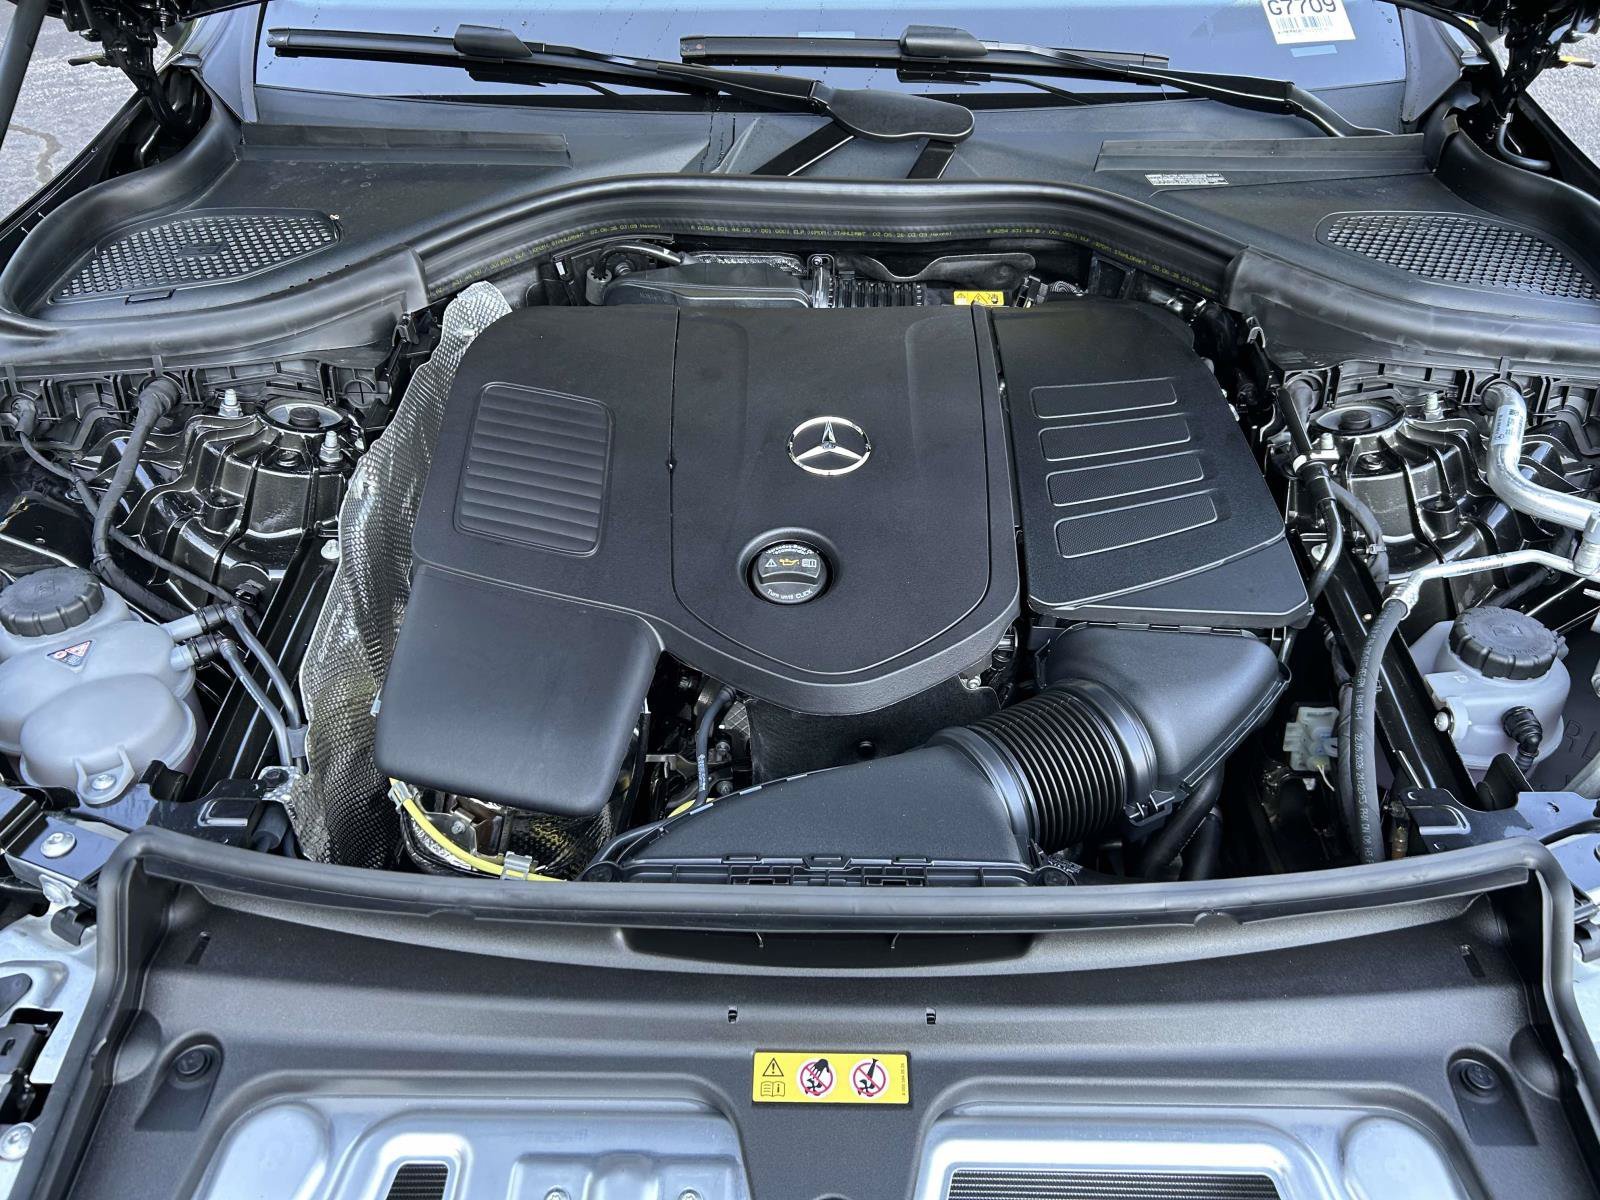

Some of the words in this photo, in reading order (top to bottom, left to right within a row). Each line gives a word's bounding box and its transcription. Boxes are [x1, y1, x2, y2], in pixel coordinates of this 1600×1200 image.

[1268, 0, 1336, 15] G7709
[767, 588, 780, 598] Turn
[795, 588, 813, 599] CLICK
